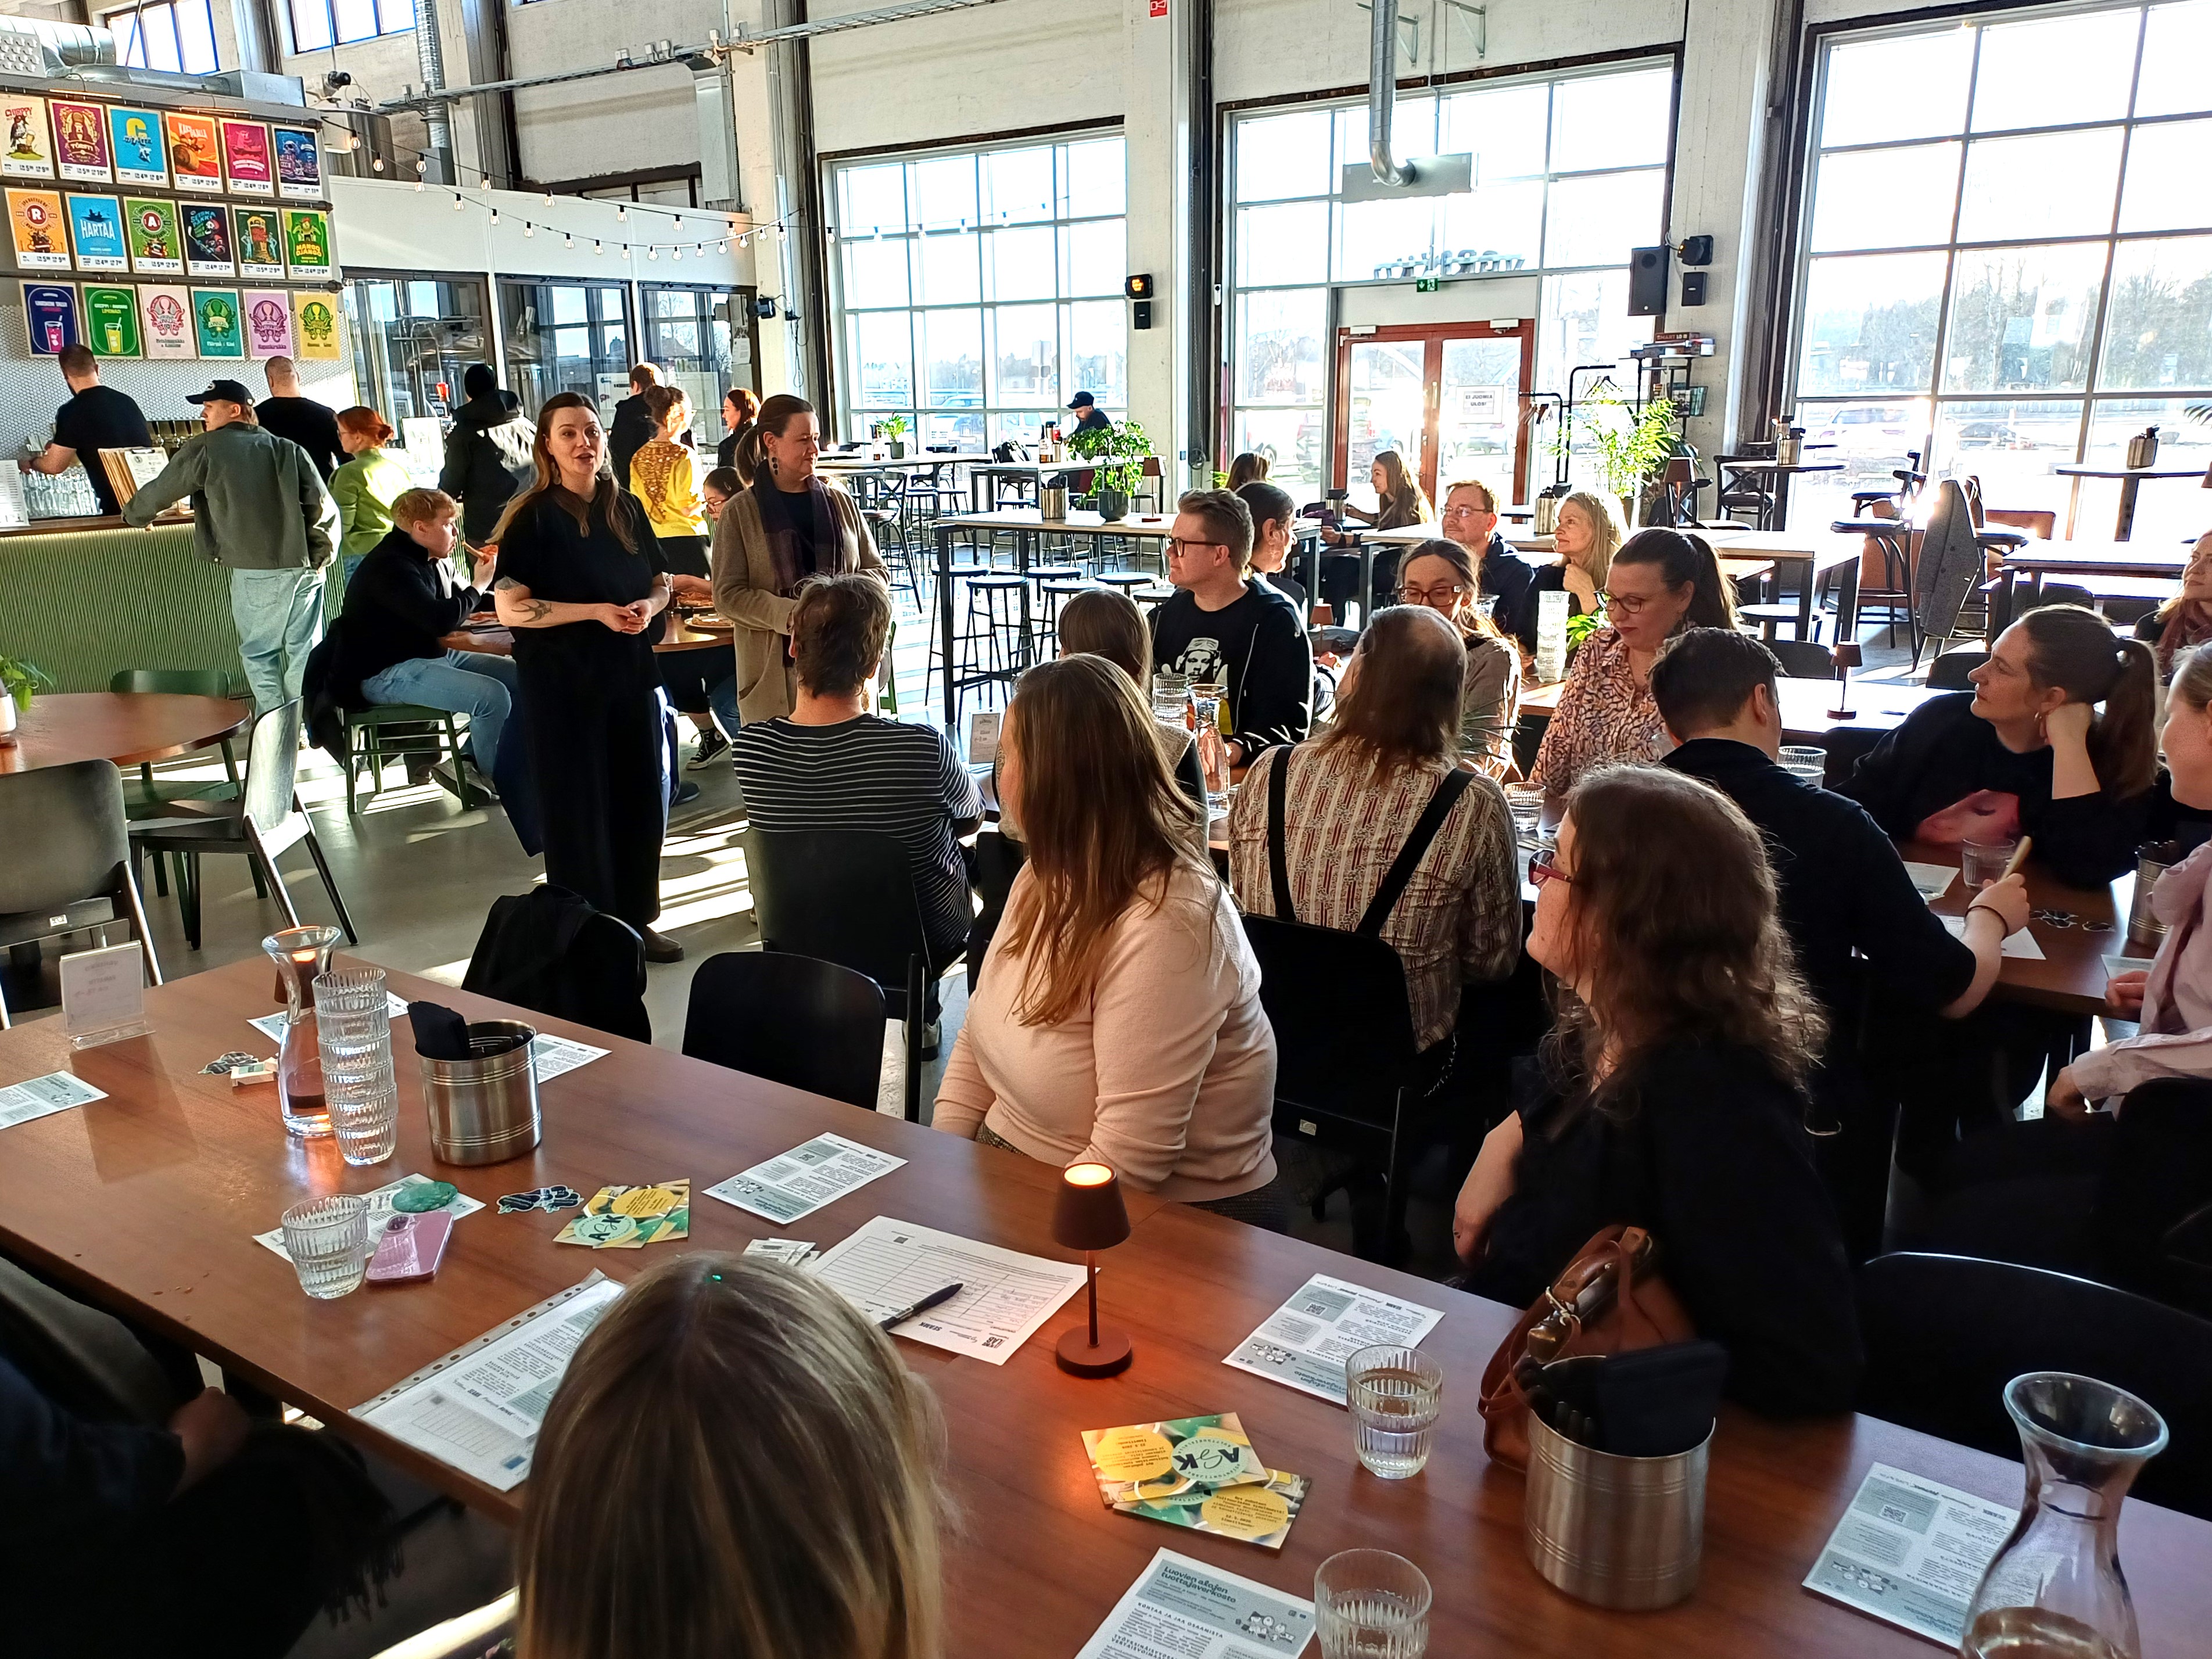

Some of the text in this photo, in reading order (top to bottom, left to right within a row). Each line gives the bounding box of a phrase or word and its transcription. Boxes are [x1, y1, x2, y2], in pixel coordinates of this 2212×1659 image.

[80, 219, 116, 240] HARTAA
[1161, 1572, 1236, 1603] tuottajaverkosto
[1164, 1566, 1228, 1595] Luovien alojen
[1138, 1602, 1162, 1615] KOHTAA
[1187, 1621, 1223, 1638] OSAAMISTA
[1112, 1637, 1165, 1659] VERTAISVOIMAA
[1114, 1634, 1177, 1659] TYÖYKSINÄISYYDES
